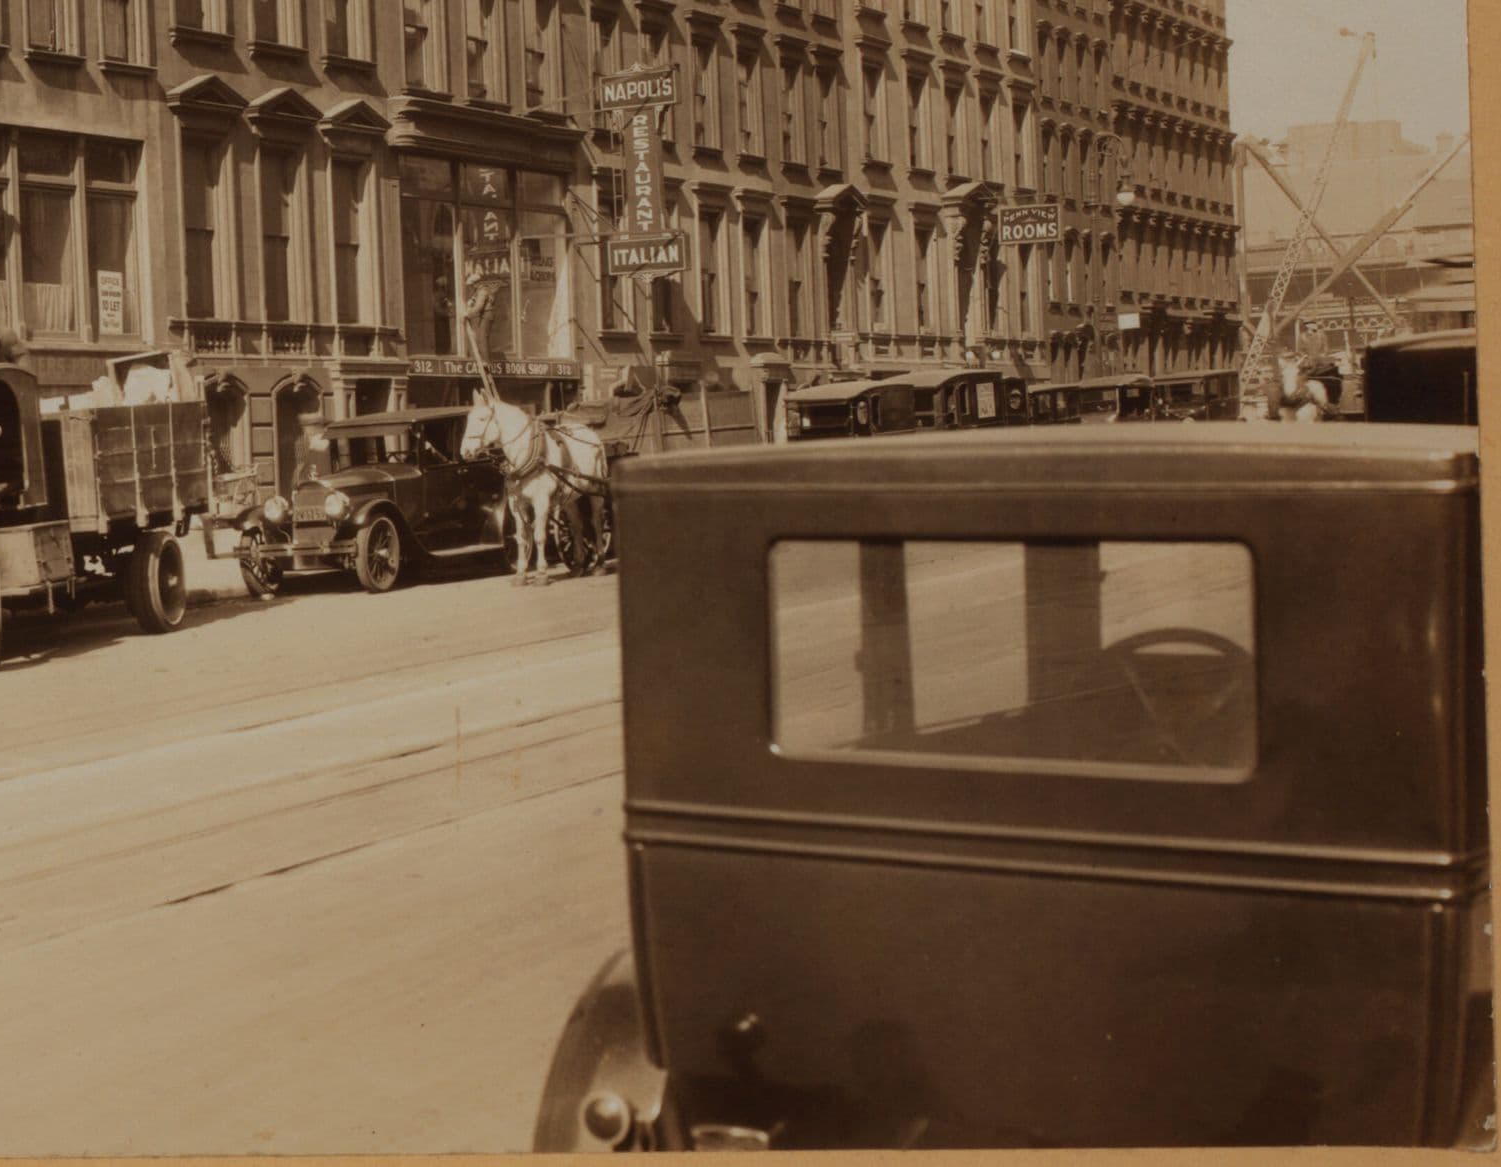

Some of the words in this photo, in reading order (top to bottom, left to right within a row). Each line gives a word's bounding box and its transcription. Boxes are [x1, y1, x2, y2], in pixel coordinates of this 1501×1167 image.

[604, 78, 672, 102] NAPOLI'S
[632, 114, 653, 232] RESTAURANT
[1002, 222, 1057, 241] ROOMS
[613, 245, 679, 266] ITALIAN
[414, 362, 433, 373] 312
[444, 362, 463, 373] The
[465, 362, 503, 375] CAUS
